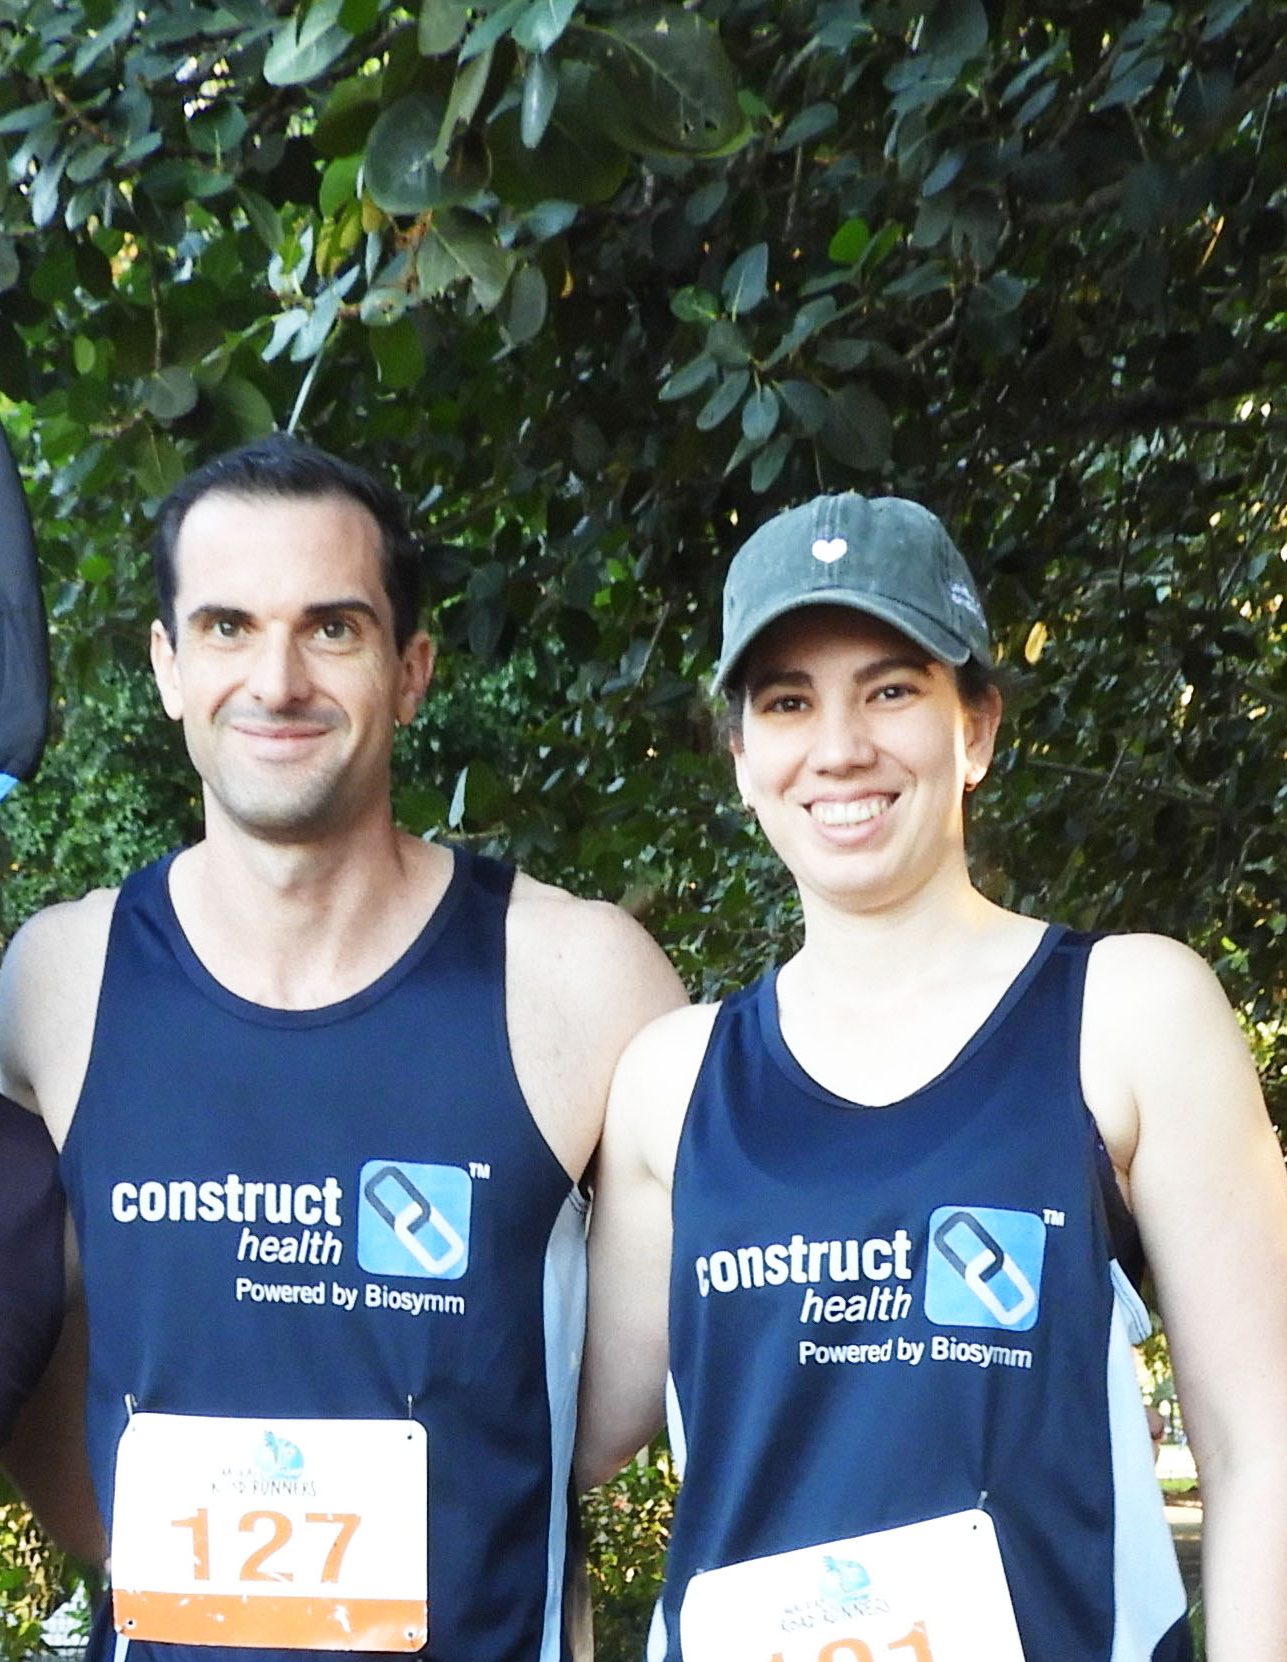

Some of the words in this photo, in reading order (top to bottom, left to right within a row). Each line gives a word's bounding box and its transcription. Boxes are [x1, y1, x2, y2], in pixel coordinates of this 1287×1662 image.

[112, 1174, 343, 1226] construct
[469, 1162, 491, 1180] TM
[236, 1227, 343, 1266] health
[695, 1229, 912, 1298] construct
[1043, 1208, 1065, 1227] TM
[235, 1277, 326, 1306] Powered
[332, 1282, 358, 1311] by
[365, 1284, 465, 1315] Biosymm
[799, 1285, 912, 1323] health
[799, 1338, 892, 1365] Powered
[897, 1337, 925, 1365] by
[931, 1336, 1033, 1369] Biosymm
[171, 1508, 363, 1583] 127
